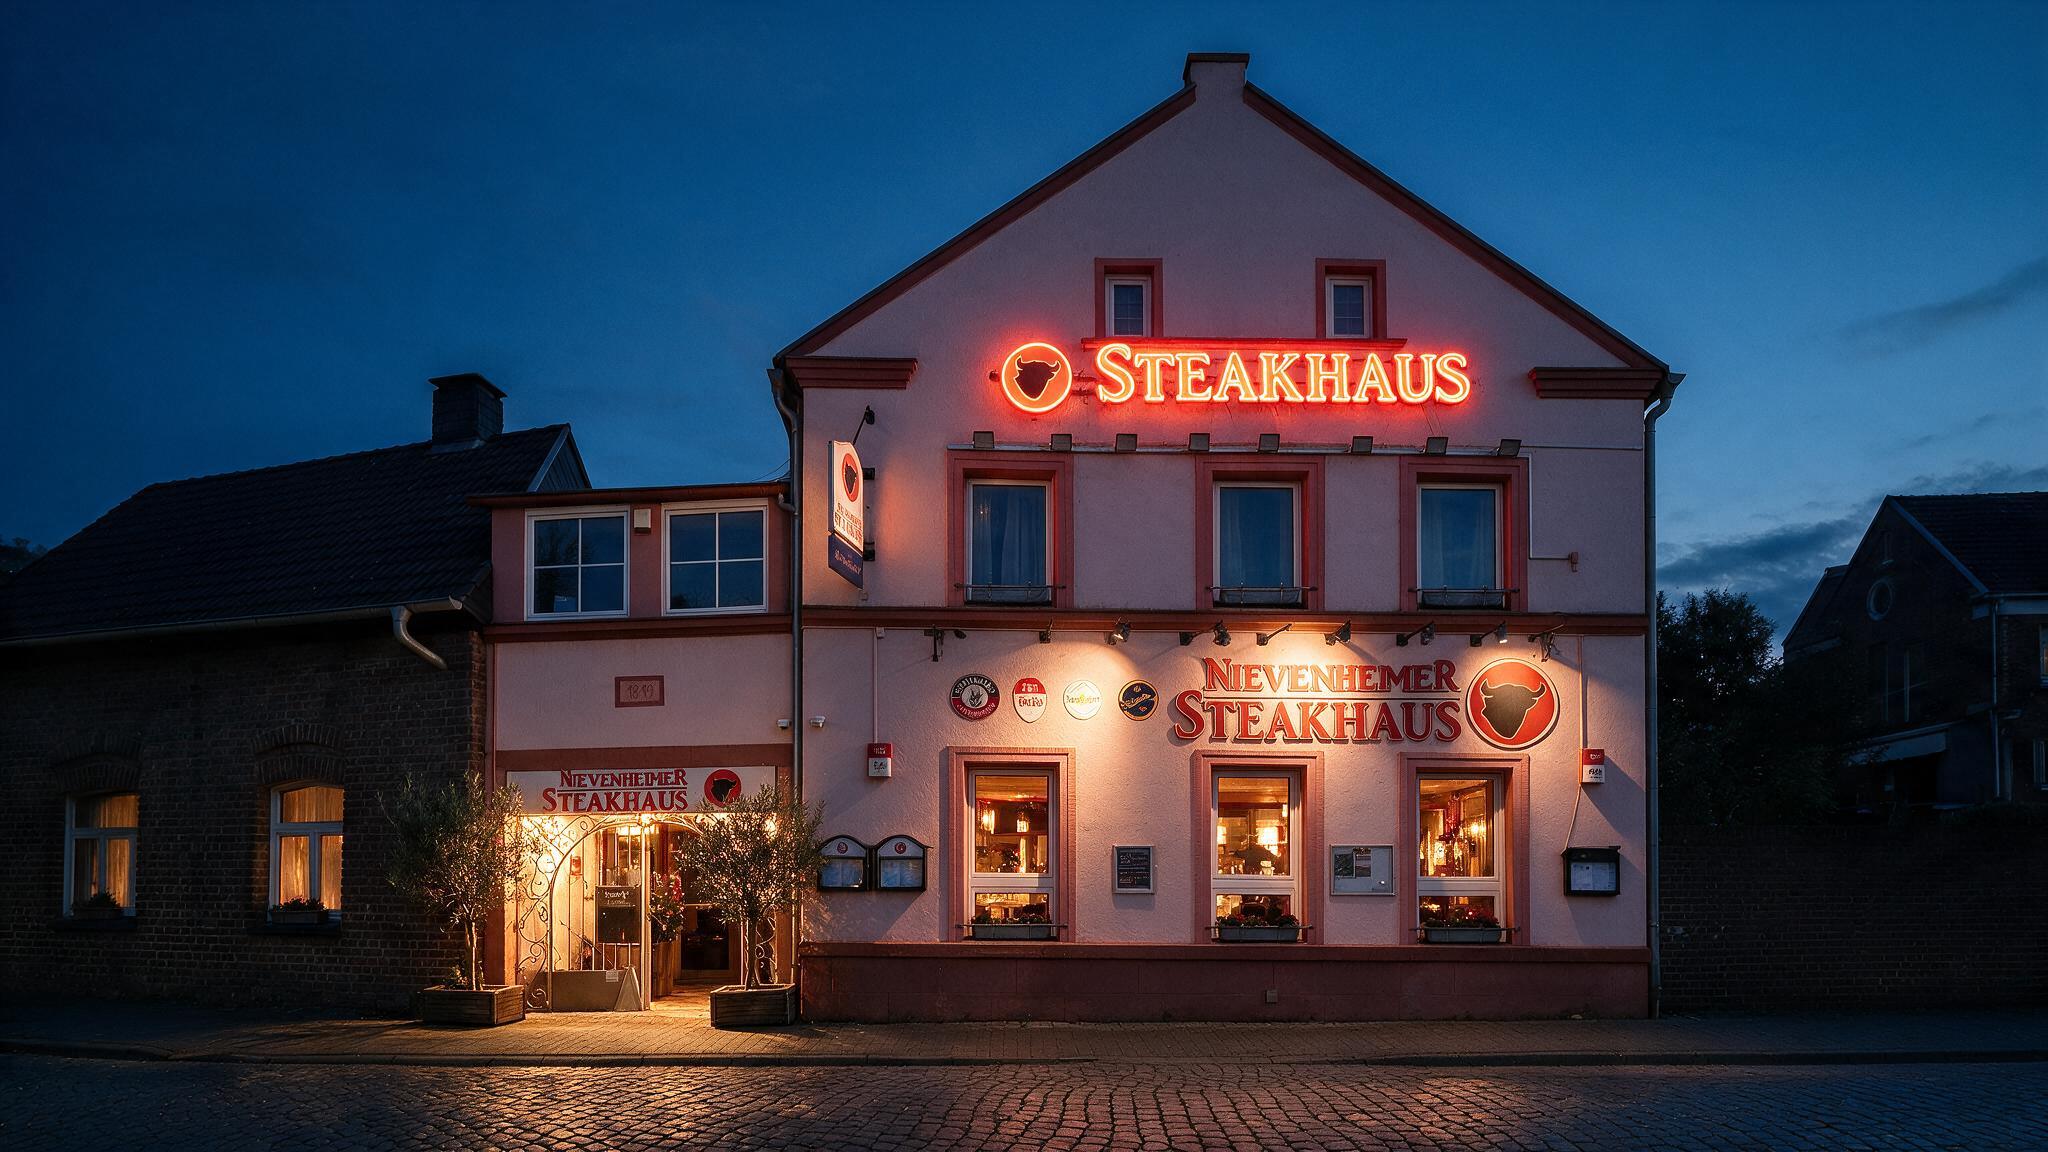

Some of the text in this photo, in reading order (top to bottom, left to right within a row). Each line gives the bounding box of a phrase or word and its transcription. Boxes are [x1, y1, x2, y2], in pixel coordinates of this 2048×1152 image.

[1095, 343, 1471, 403] STEAKHAUS
[1174, 690, 1462, 742] STEAKHAUS
[542, 787, 689, 812] STEAKHAUS
